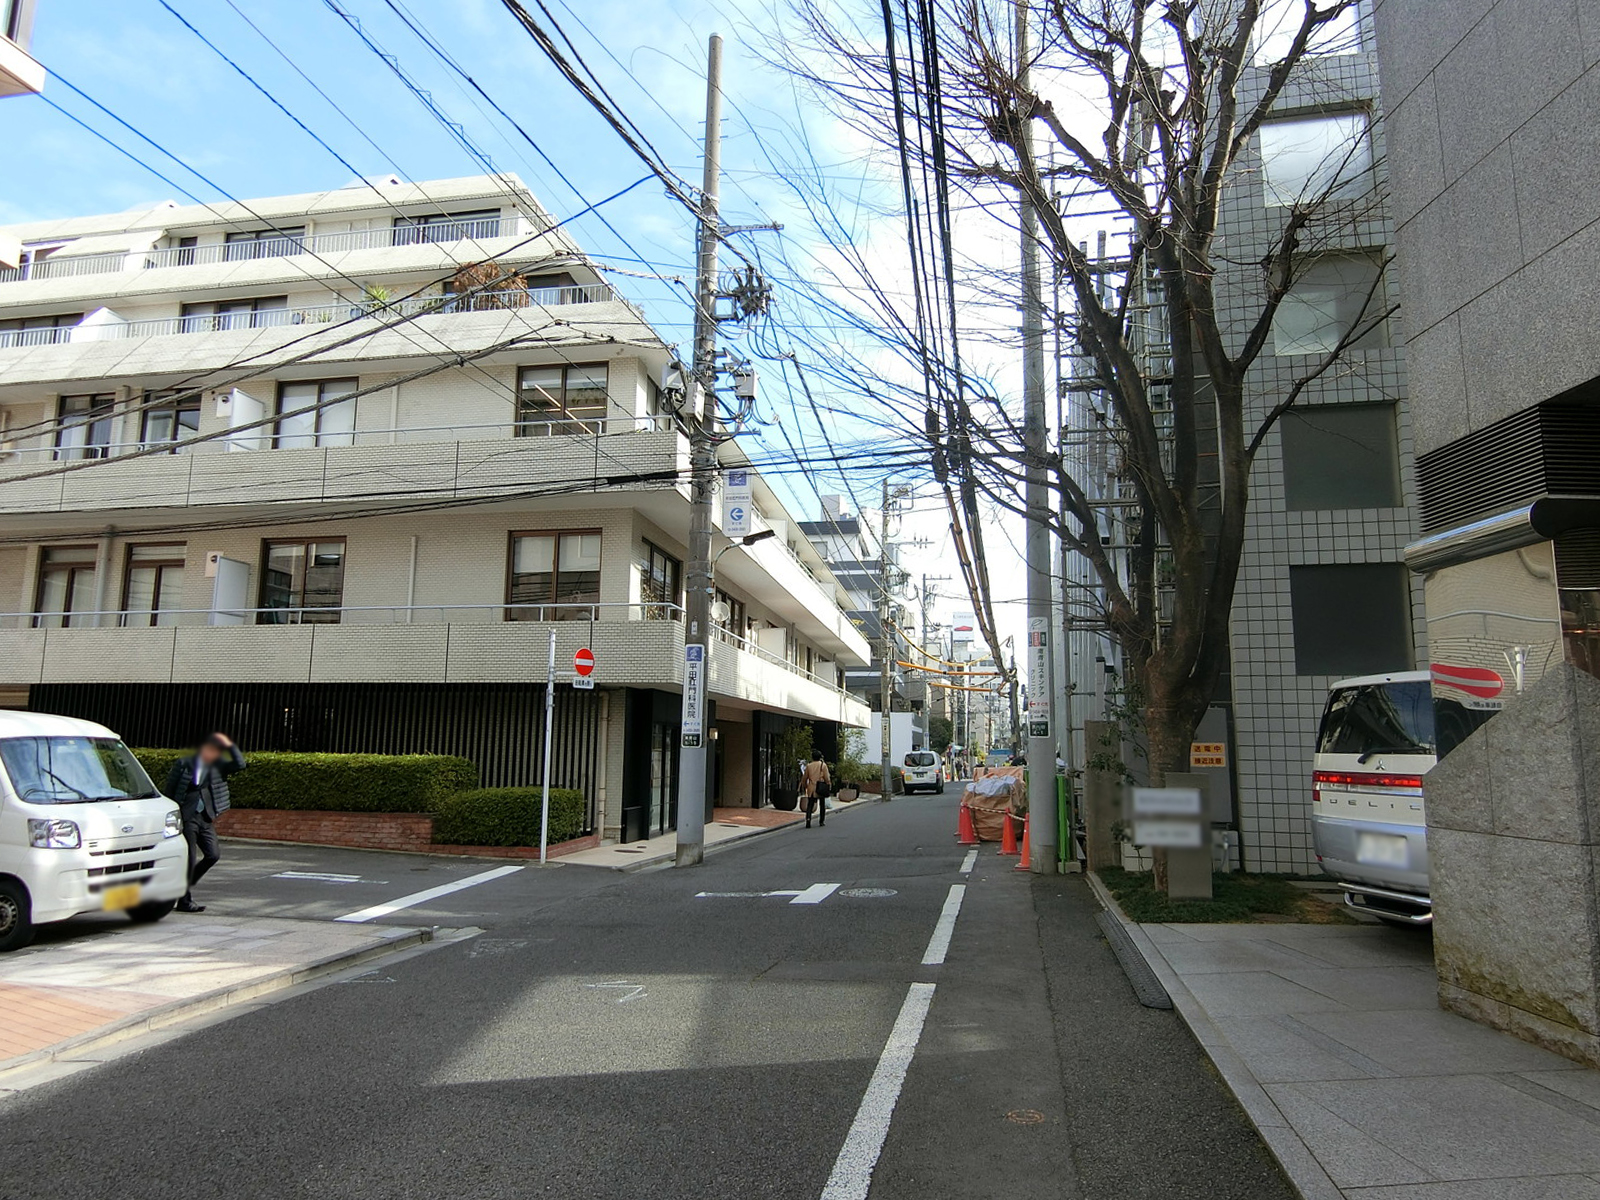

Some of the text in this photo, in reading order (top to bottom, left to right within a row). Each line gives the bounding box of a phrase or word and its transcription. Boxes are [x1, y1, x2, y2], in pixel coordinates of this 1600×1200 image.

[688, 662, 698, 719] 平田肛門科医院
[1194, 745, 1222, 753] 送電中
[1194, 757, 1222, 765] 接近注意
[1329, 798, 1422, 811] DELIC
